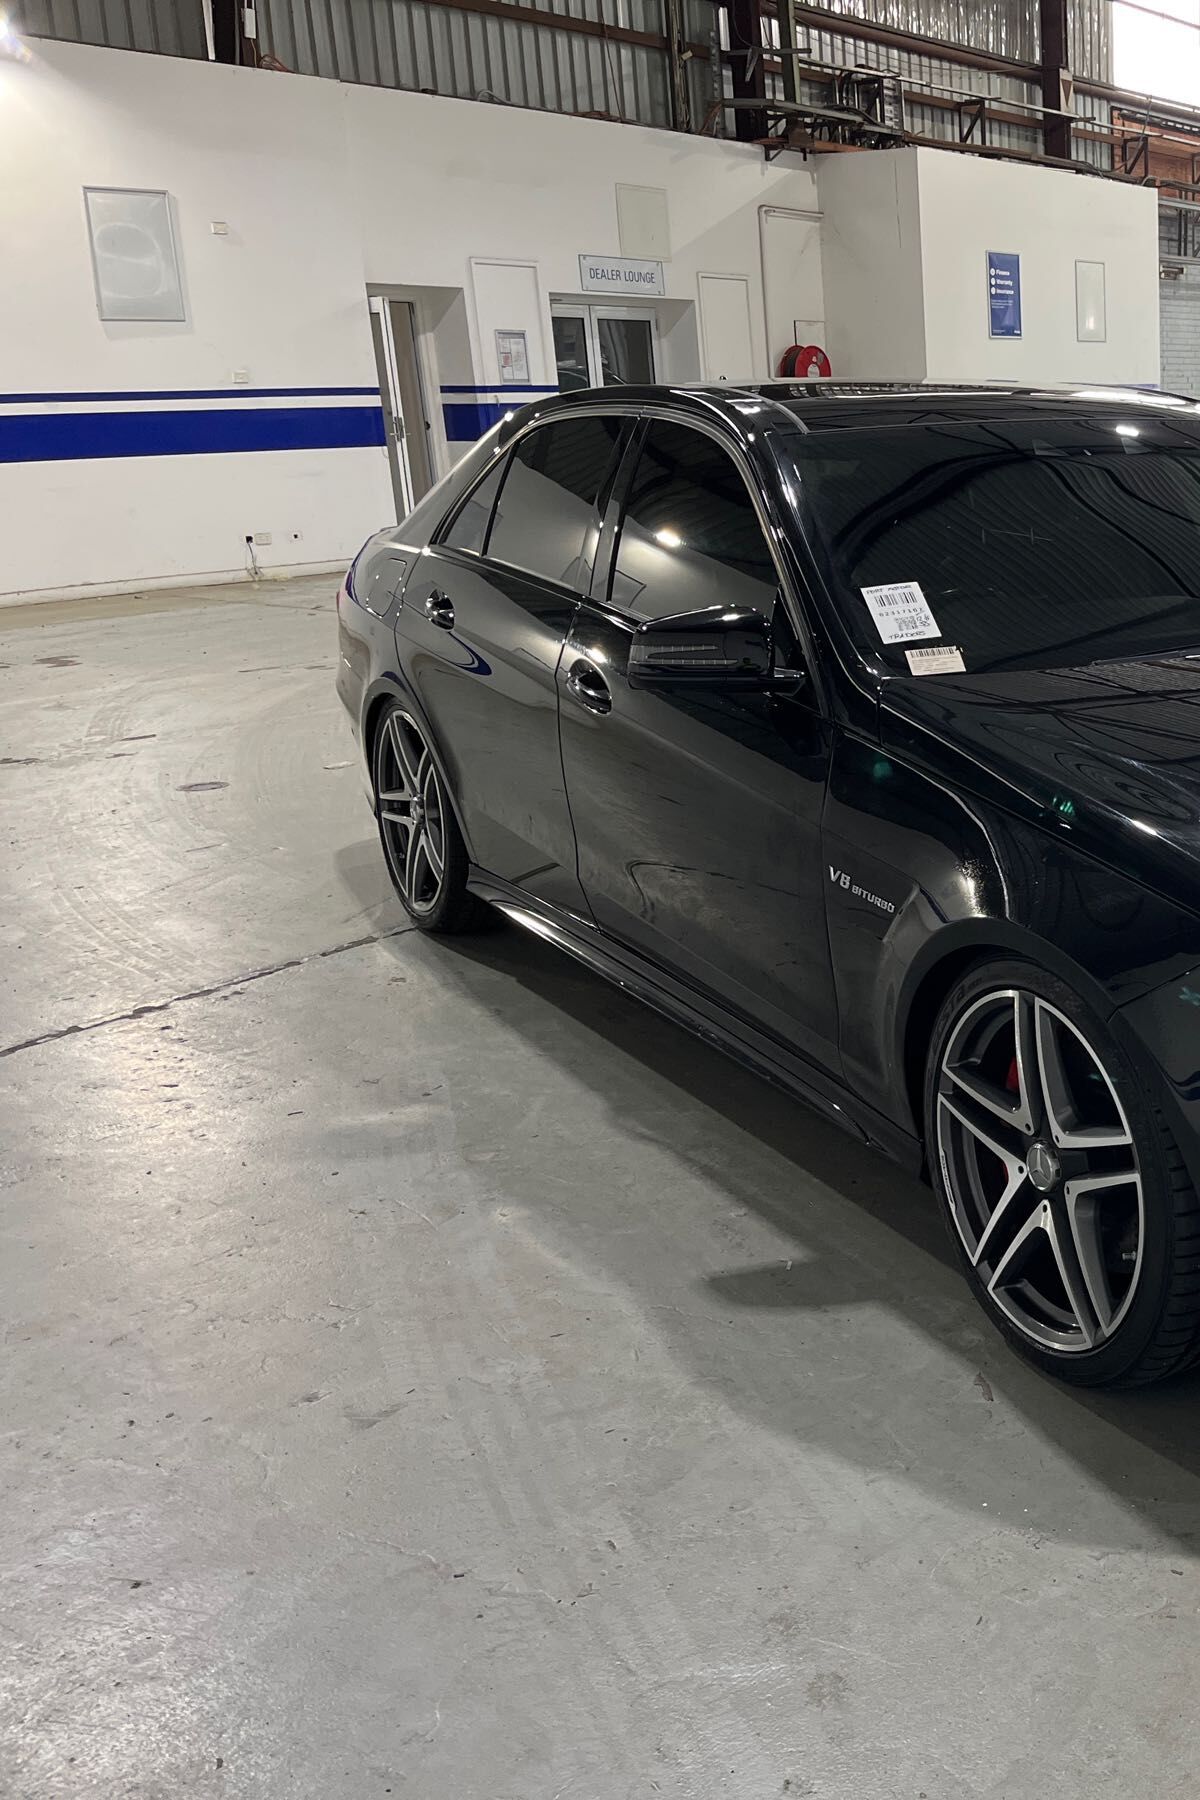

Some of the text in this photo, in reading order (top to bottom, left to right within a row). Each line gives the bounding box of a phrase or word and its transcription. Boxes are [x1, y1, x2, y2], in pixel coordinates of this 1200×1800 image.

[589, 267, 656, 284] DEALER LOUNGE
[829, 864, 895, 913] V8 BITURBO
